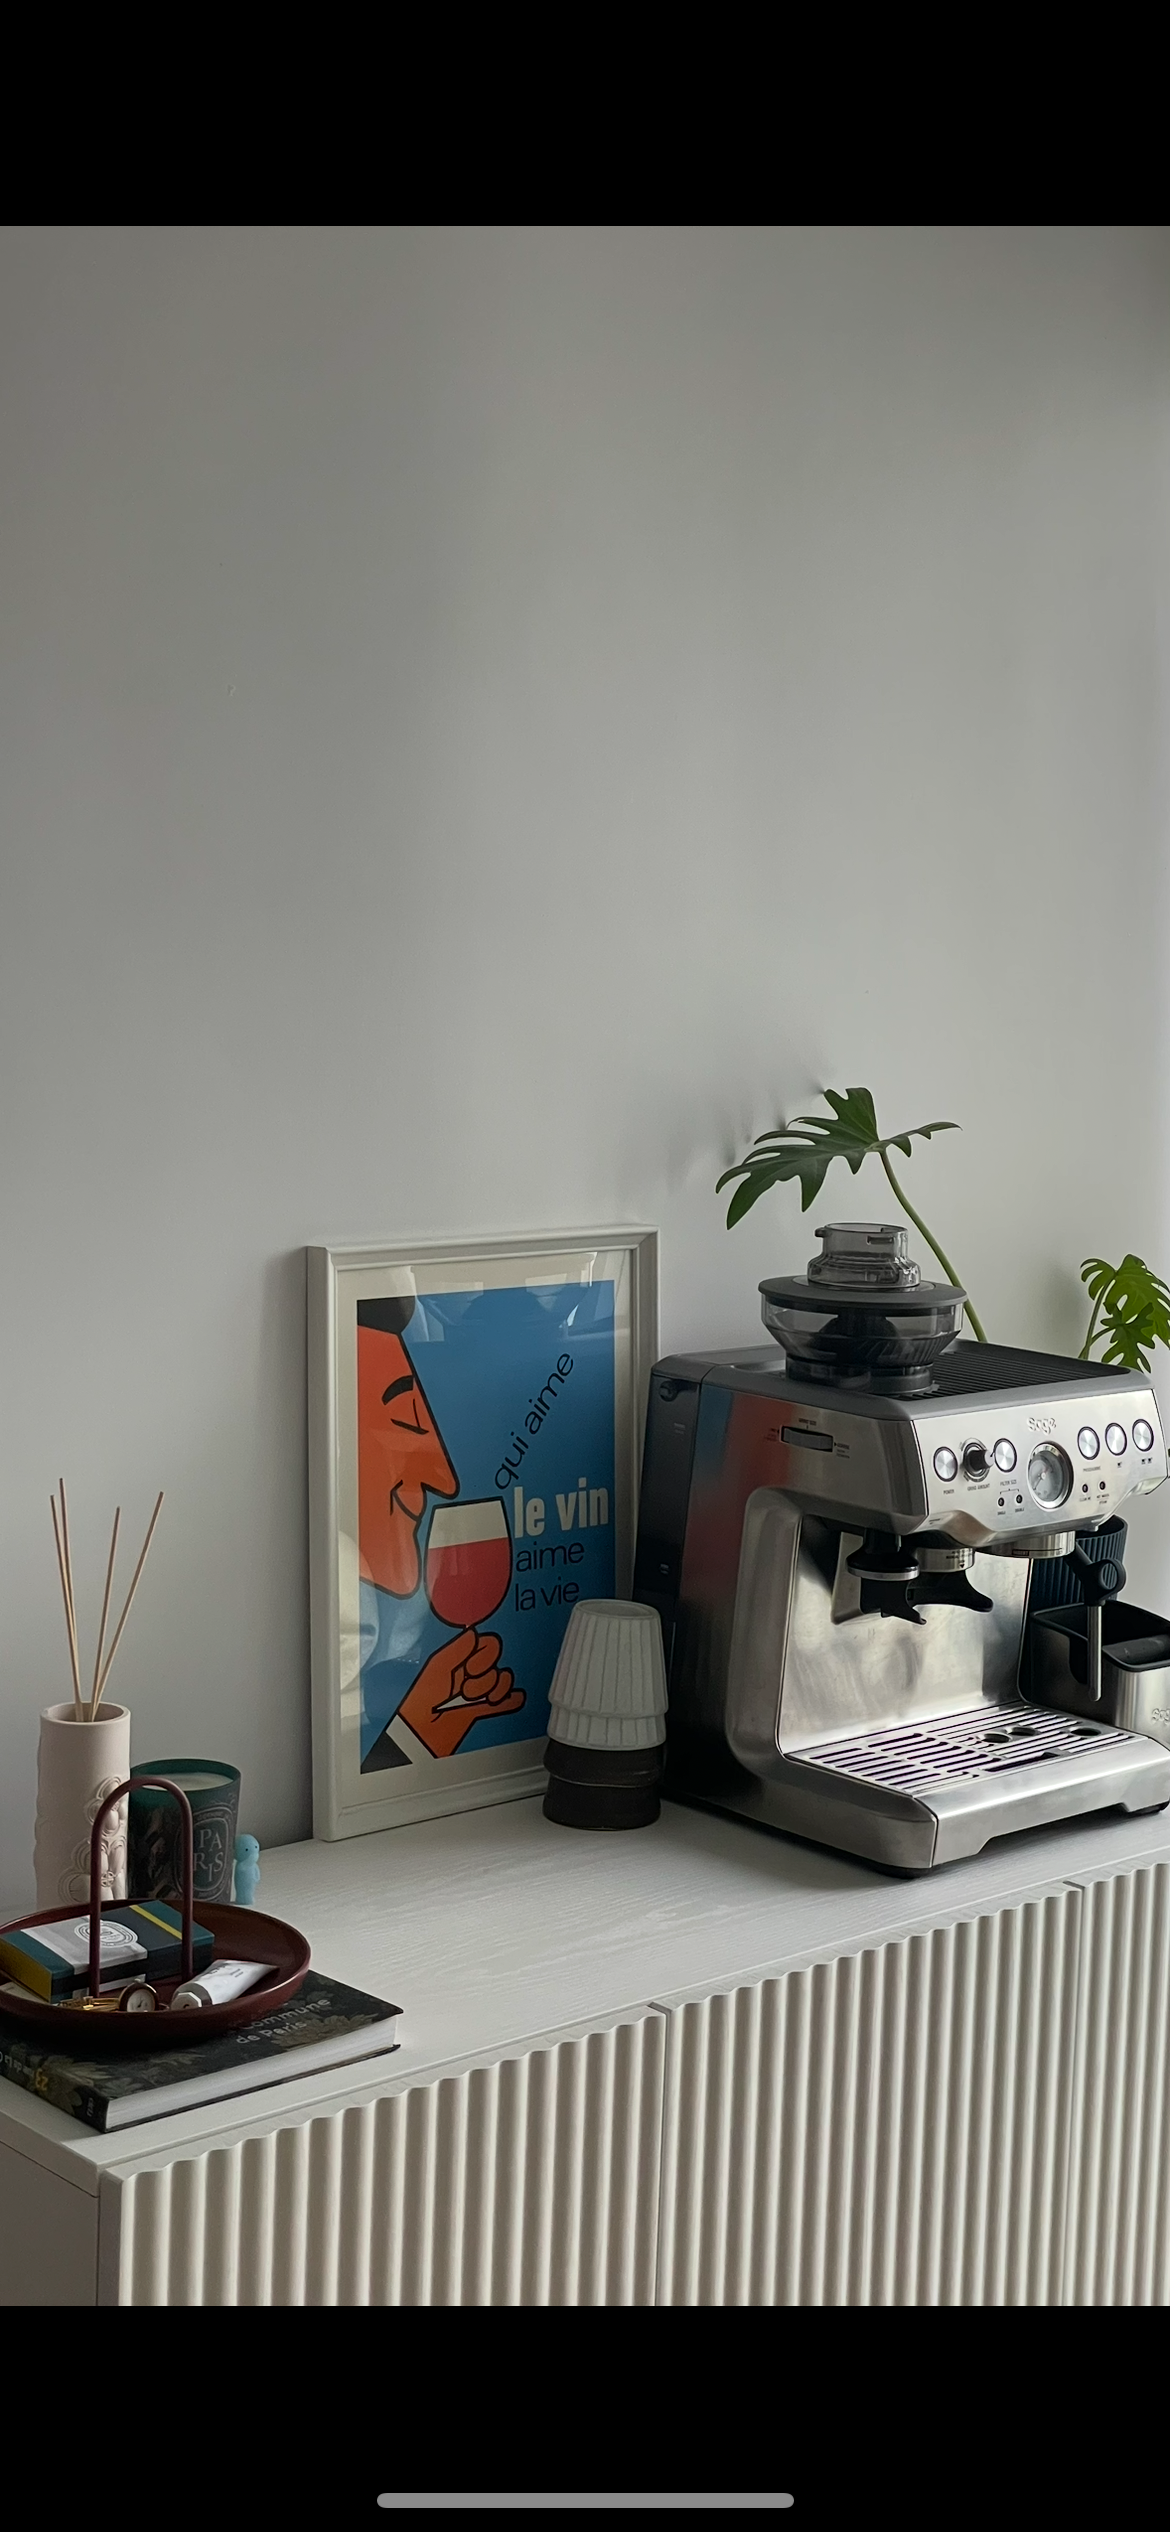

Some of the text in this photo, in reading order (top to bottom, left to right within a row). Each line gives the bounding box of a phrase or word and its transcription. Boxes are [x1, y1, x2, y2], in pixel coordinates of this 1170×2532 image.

[494, 1353, 575, 1490] qui aime
[513, 1476, 609, 1539] le vin
[515, 1541, 585, 1573] aime
[515, 1576, 580, 1612] la vie
[236, 2021, 308, 2044] de Paris
